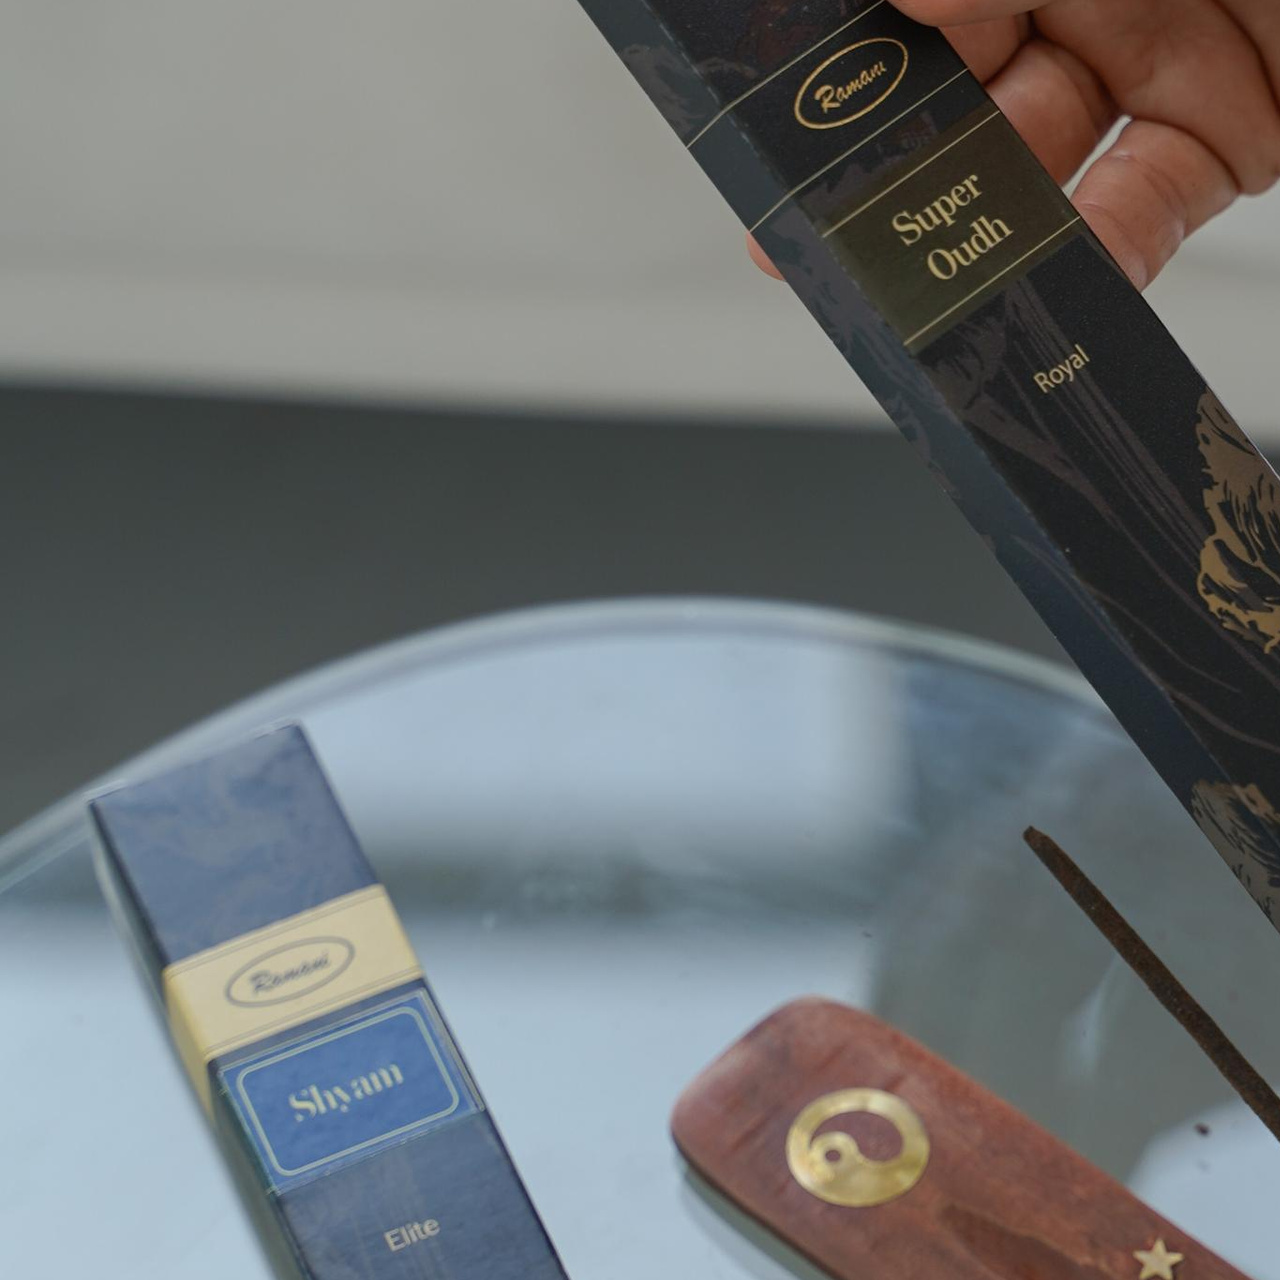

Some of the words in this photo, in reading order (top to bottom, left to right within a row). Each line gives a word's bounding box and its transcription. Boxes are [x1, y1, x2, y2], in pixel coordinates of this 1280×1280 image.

[813, 60, 887, 114] Ramani
[891, 173, 983, 246] Super
[927, 214, 1013, 282] Oudh
[1033, 344, 1091, 393] Royal
[288, 1063, 405, 1122] Shyam
[383, 1217, 441, 1252] Elite
